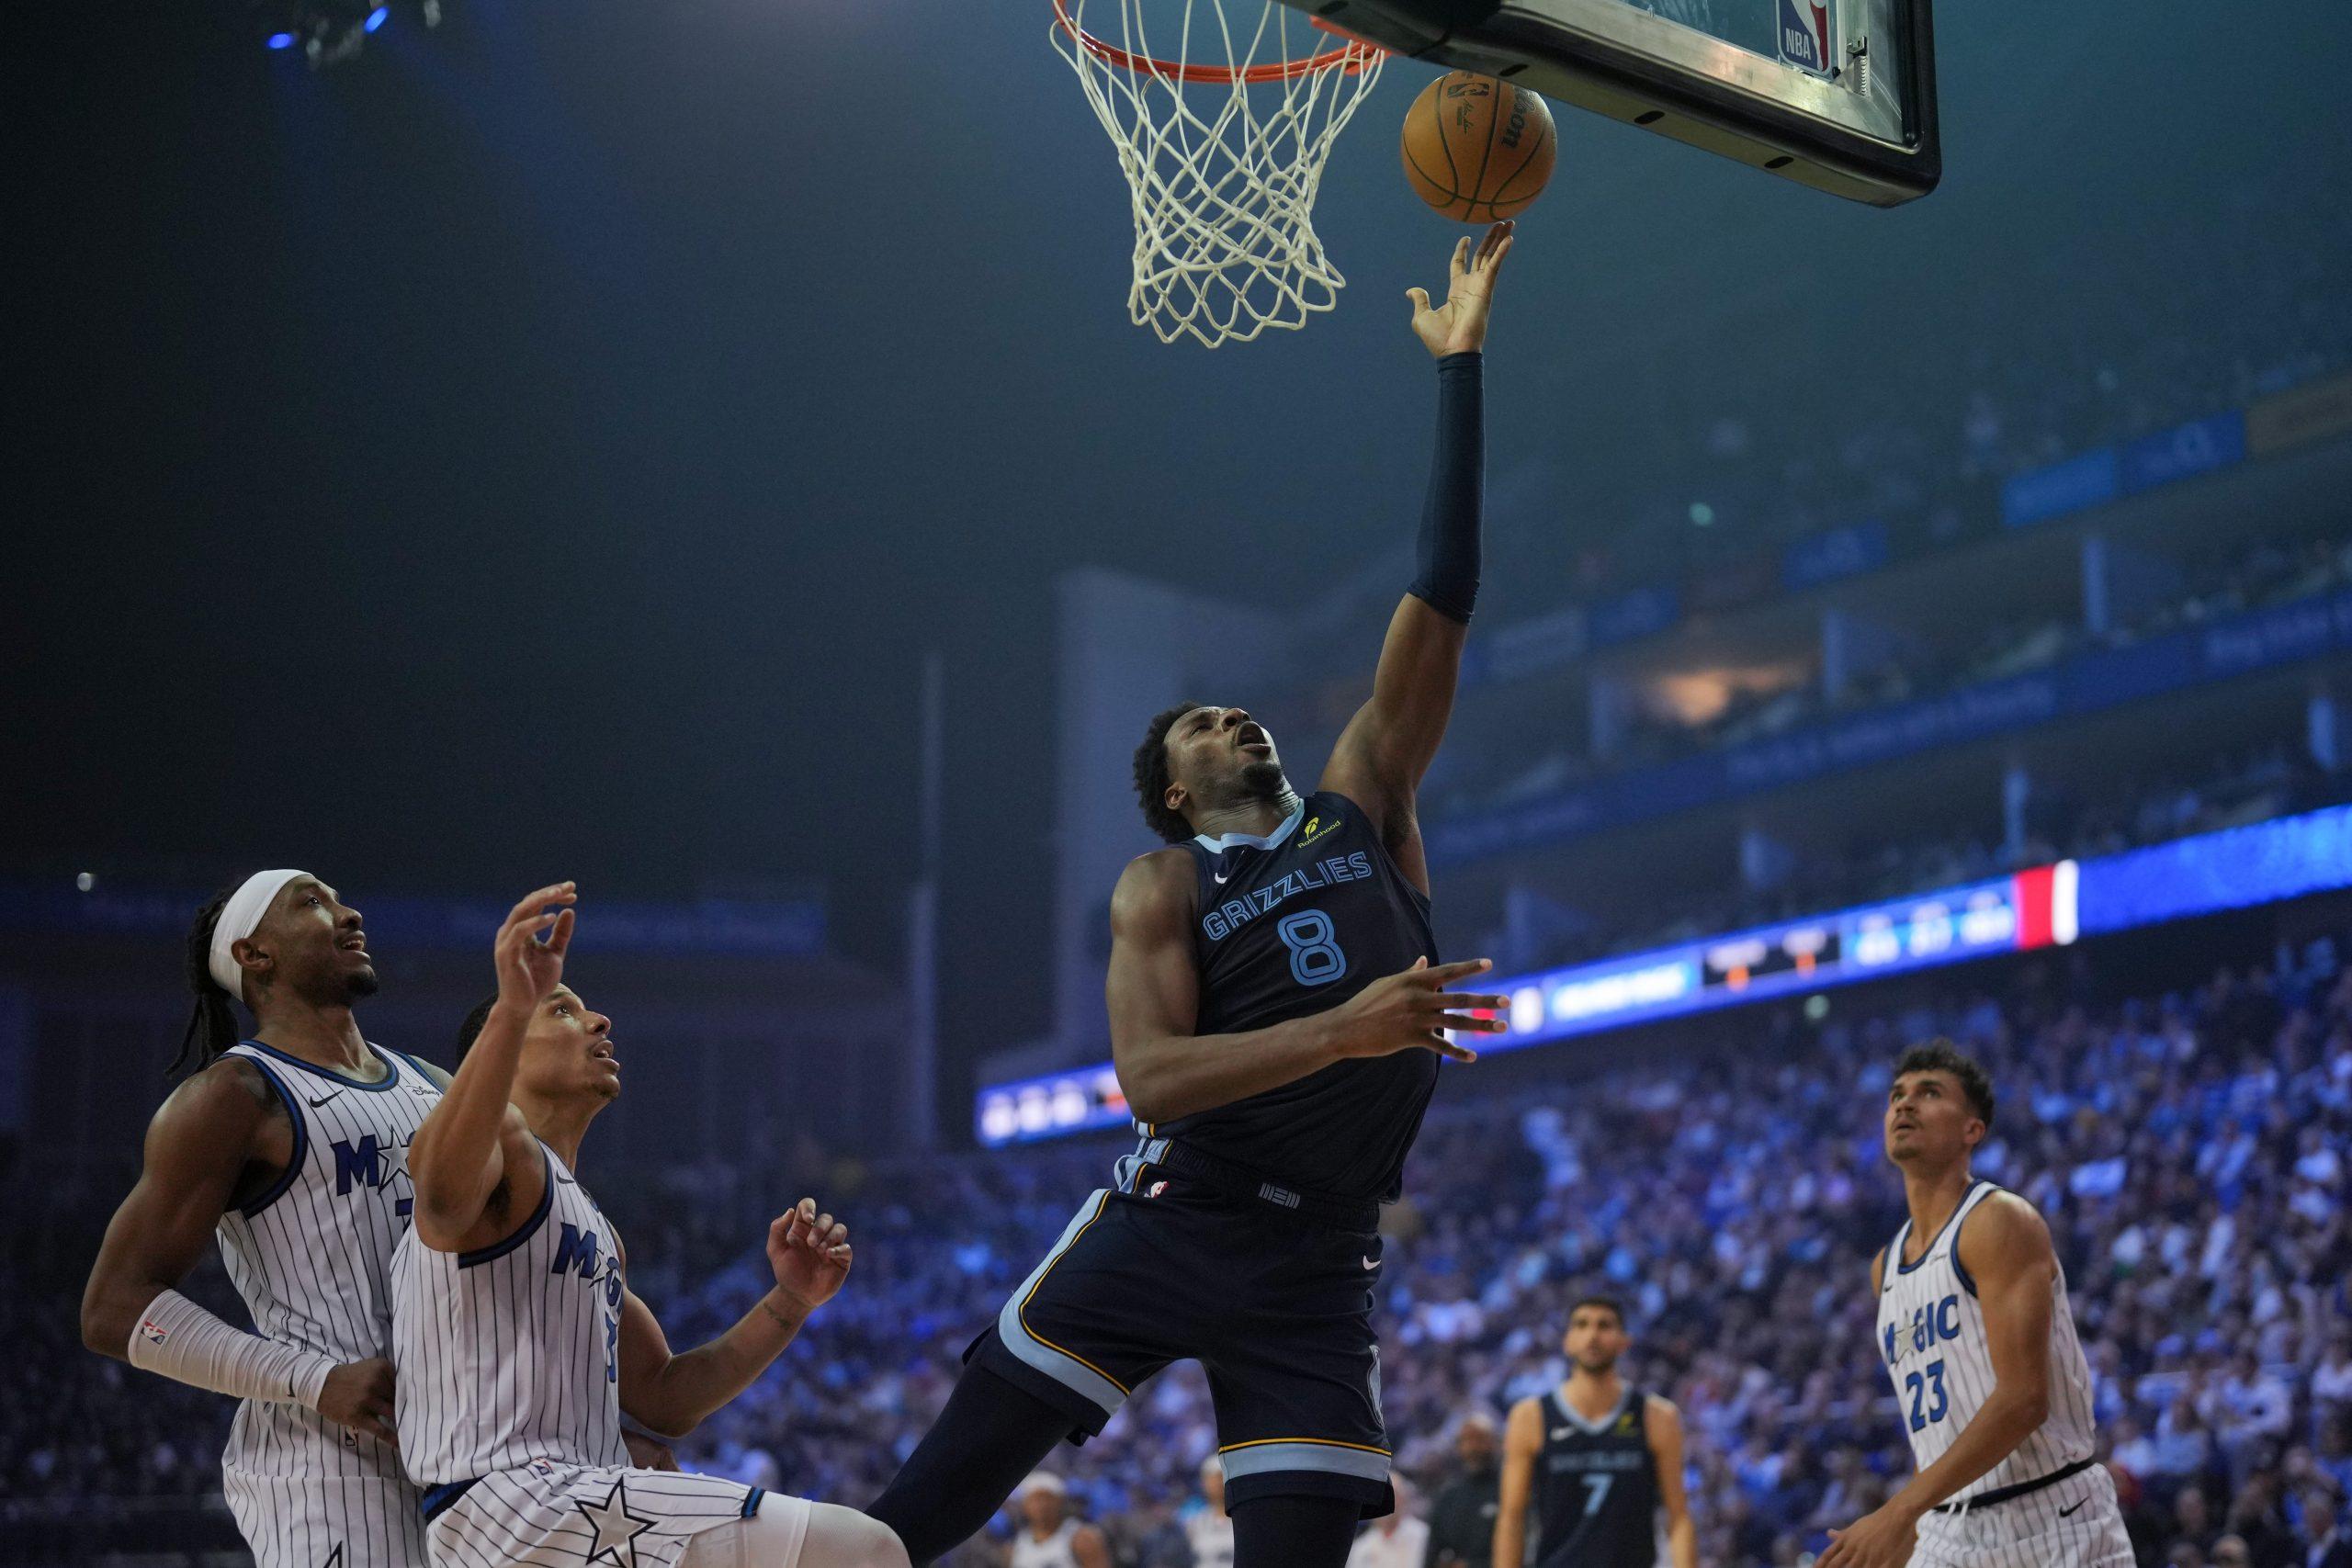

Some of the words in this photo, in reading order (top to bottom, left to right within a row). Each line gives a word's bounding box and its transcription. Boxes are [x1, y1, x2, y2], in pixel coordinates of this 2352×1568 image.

[1785, 28, 1812, 61] NBA
[1297, 819, 1341, 849] Robinhood
[1203, 851, 1373, 942] GRIZZLIES
[1277, 908, 1347, 987] 8
[1905, 1359, 1949, 1433] 23
[1581, 1472, 1614, 1517] 7
